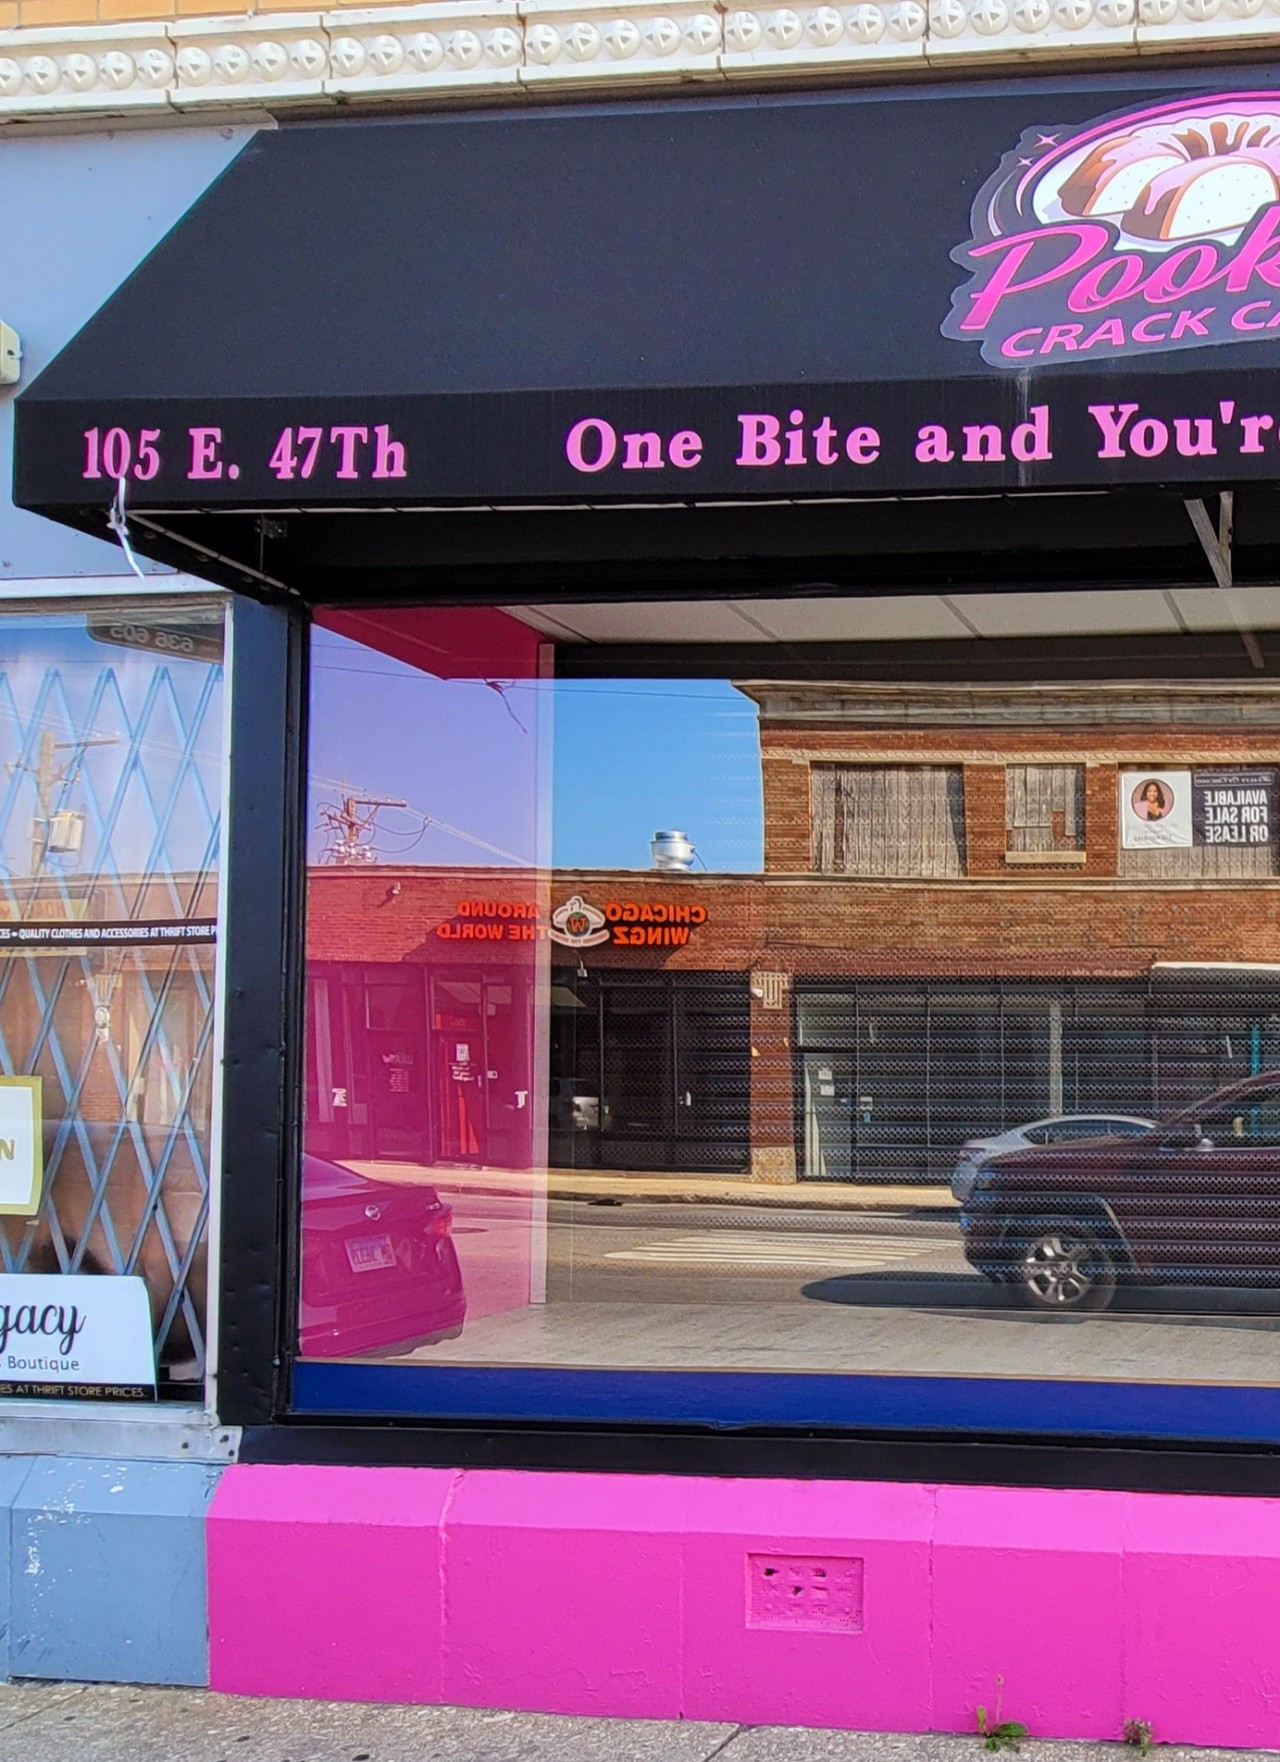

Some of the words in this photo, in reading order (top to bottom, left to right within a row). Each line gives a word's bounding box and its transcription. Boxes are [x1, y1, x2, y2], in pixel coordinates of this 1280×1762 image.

[1001, 307, 1221, 359] CRACK
[82, 426, 161, 481] 105
[187, 427, 240, 480] E.
[268, 424, 407, 480] 47Th
[565, 418, 704, 473] One
[735, 409, 882, 466] Bite
[914, 405, 1053, 463] and
[19, 928, 50, 941] QUALITY
[51, 928, 83, 939] CLOTHES
[83, 928, 101, 939] AND
[101, 927, 149, 939] ACCESSORIES
[150, 927, 159, 938] AT
[159, 927, 186, 937] THRIFT
[186, 925, 210, 936] STORE
[8, 1356, 80, 1373] Boutique
[15, 1384, 29, 1394] AT
[32, 1384, 65, 1396] THRIFT
[68, 1385, 102, 1397] STORE
[105, 1386, 148, 1398] PRICES.
